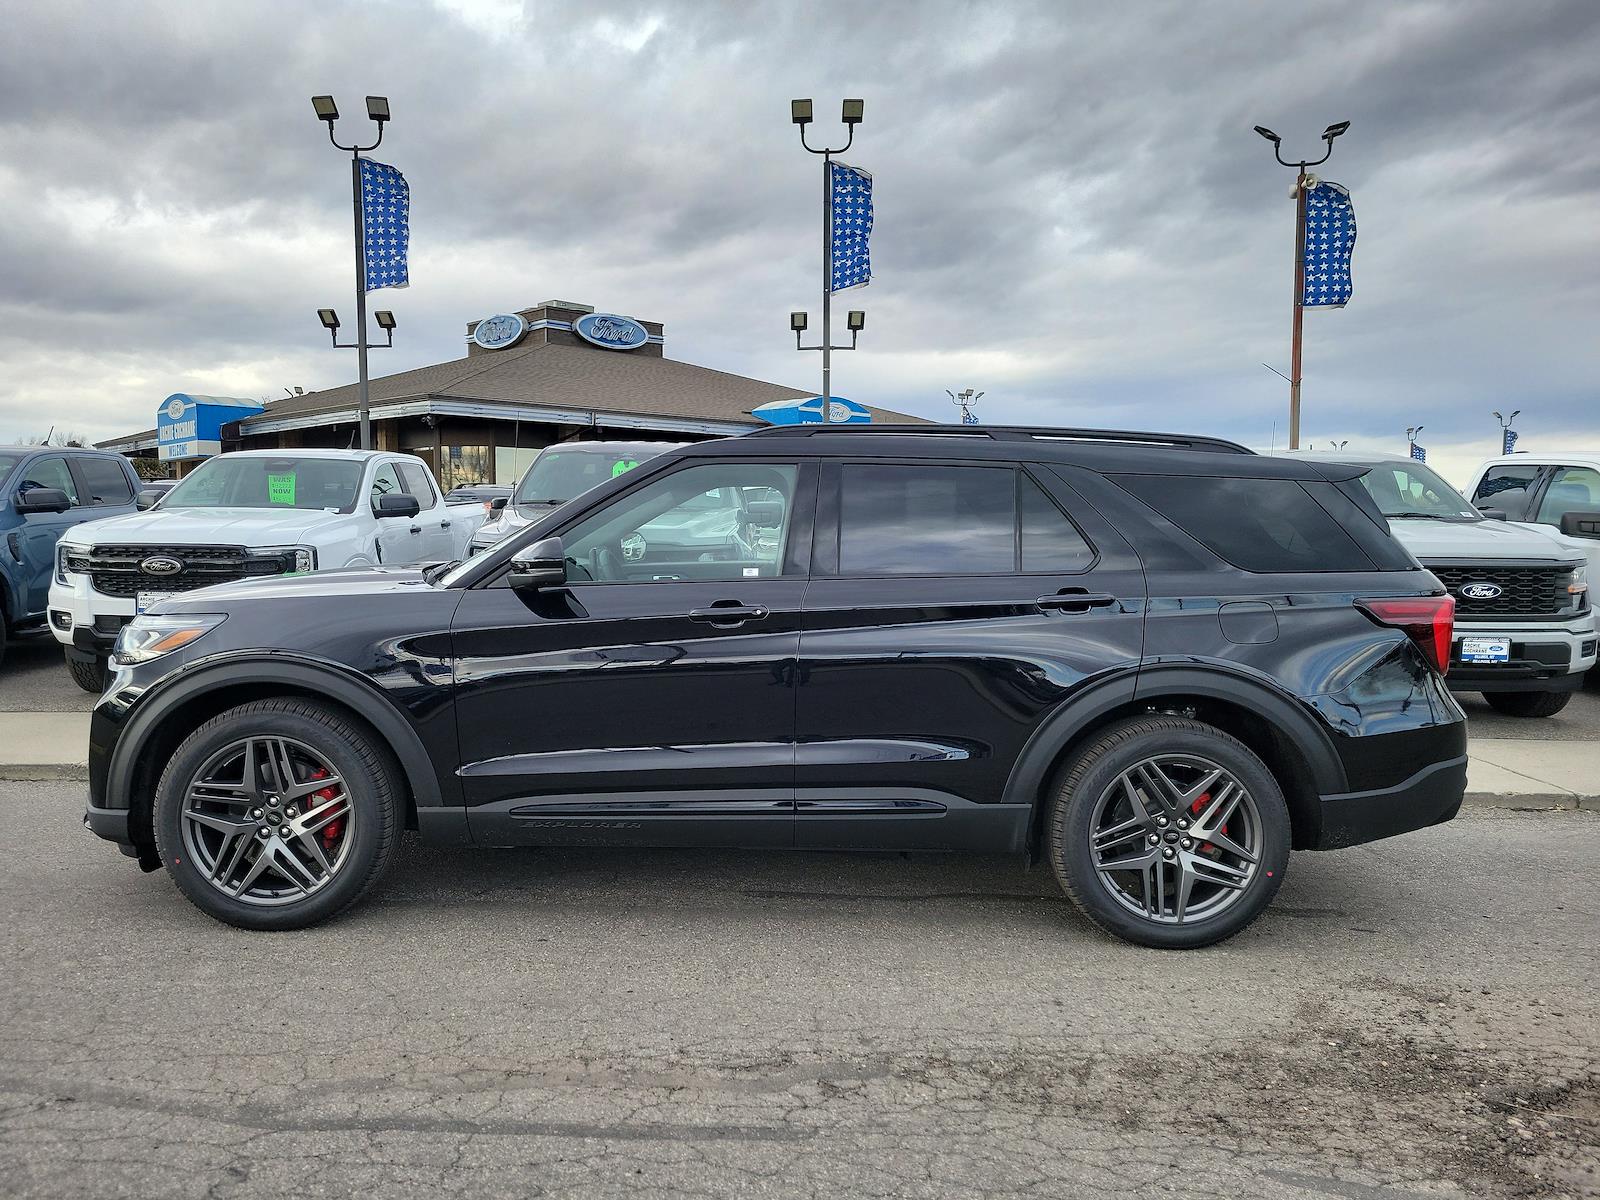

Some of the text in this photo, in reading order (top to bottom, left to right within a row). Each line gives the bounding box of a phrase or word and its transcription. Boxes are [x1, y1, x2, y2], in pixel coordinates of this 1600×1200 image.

[591, 316, 636, 343] Ford
[168, 444, 188, 456] WELCOME
[149, 561, 172, 571] Ford
[1469, 585, 1495, 597] Ford
[520, 821, 641, 829] EXPLORER
